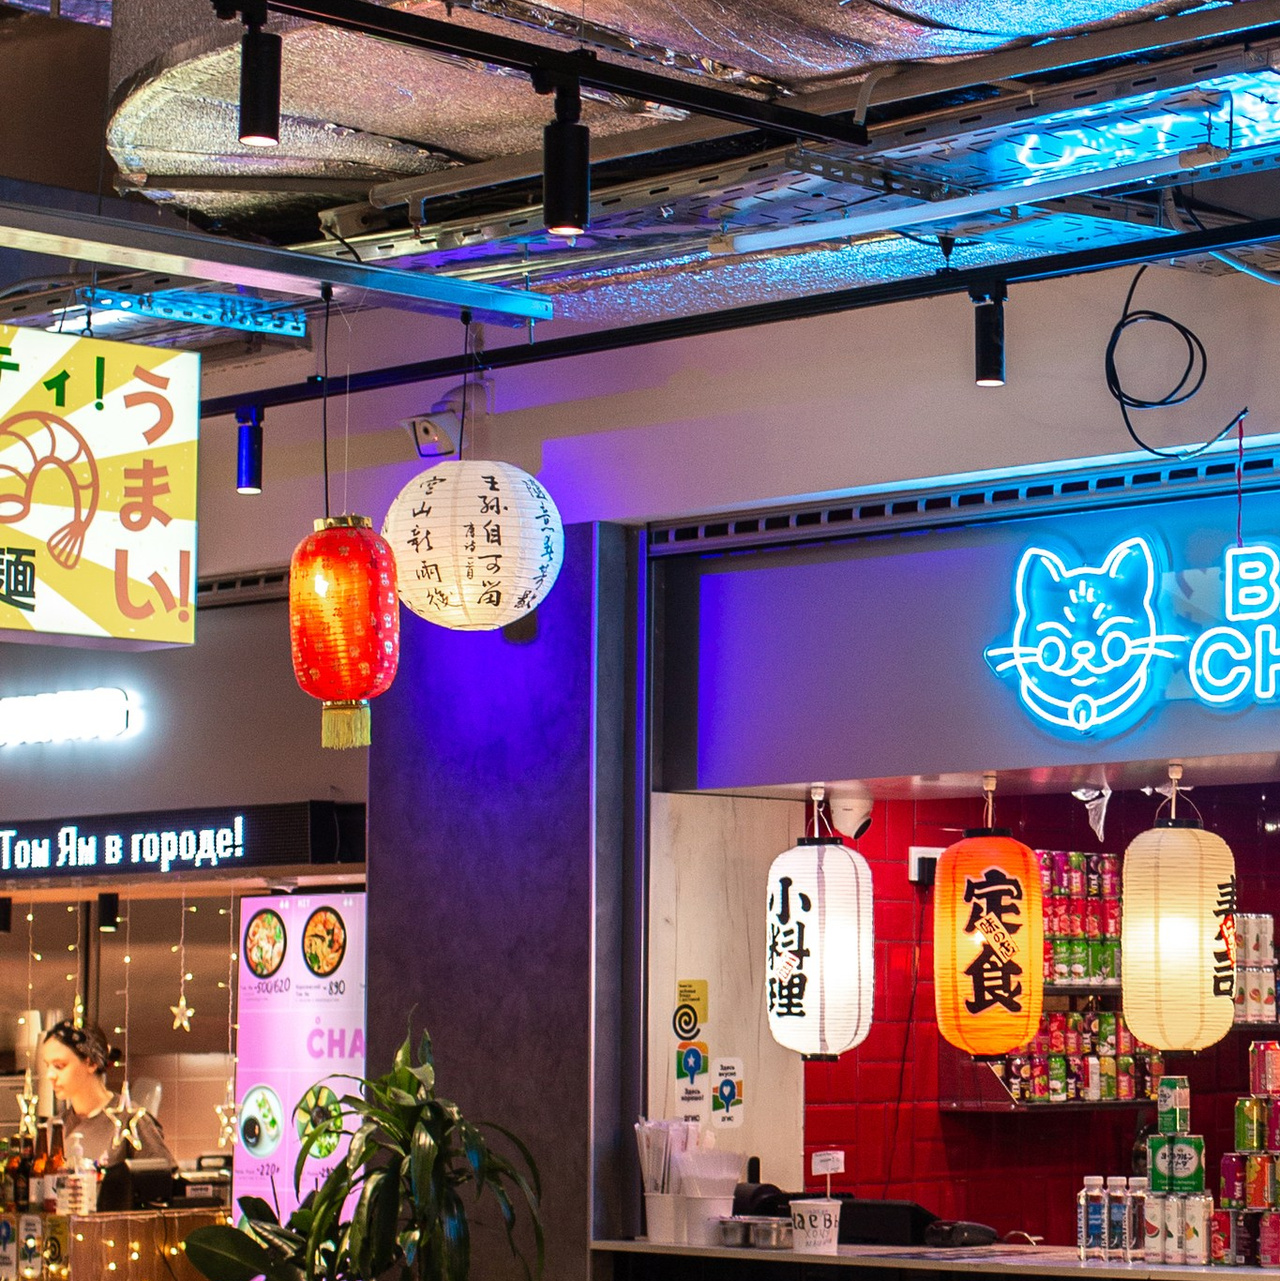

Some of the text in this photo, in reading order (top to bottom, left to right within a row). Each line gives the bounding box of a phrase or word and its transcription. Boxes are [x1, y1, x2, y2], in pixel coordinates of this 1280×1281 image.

[115, 364, 190, 623] うまい!
[0, 815, 244, 872] Том Ям в городе!
[964, 869, 1023, 1014] 定食
